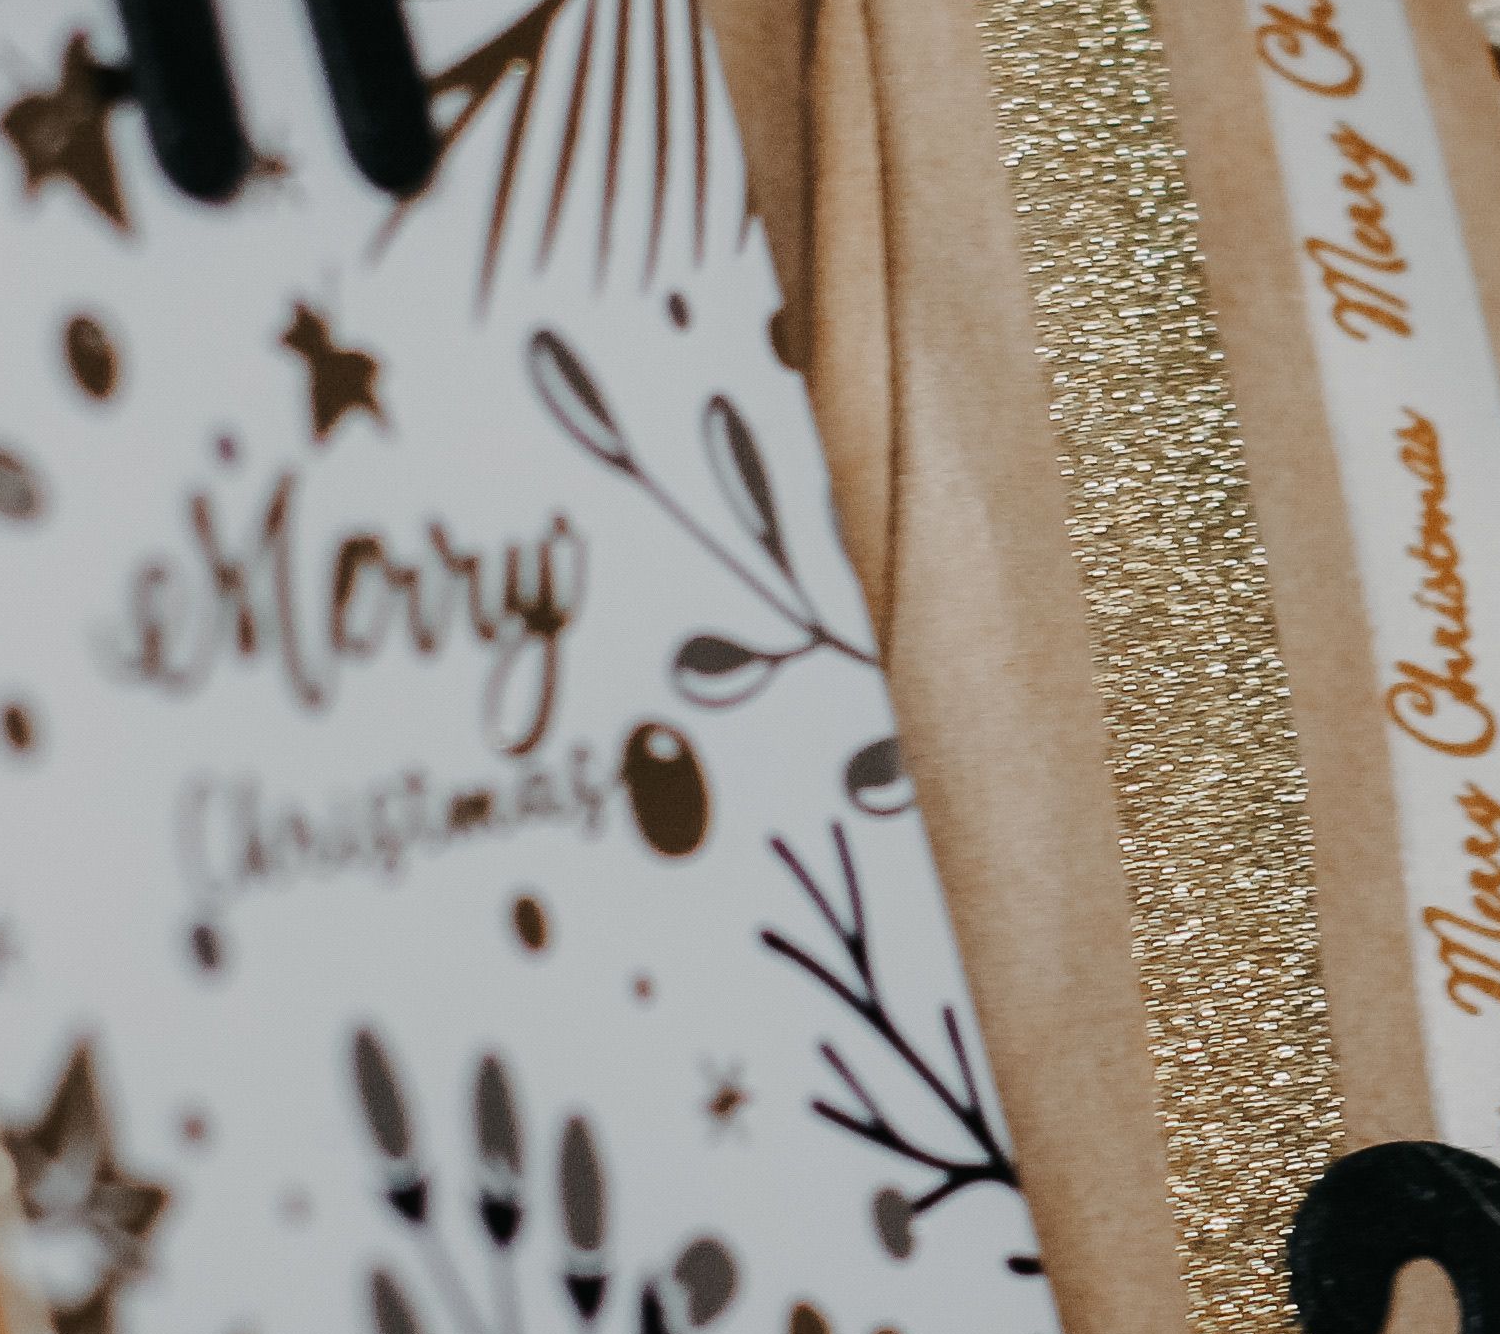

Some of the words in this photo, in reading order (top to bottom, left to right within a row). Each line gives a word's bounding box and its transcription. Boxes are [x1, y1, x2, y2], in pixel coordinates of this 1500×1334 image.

[1304, 122, 1414, 341] Merry
[98, 469, 587, 755] Merry
[1385, 406, 1497, 757] Christmas
